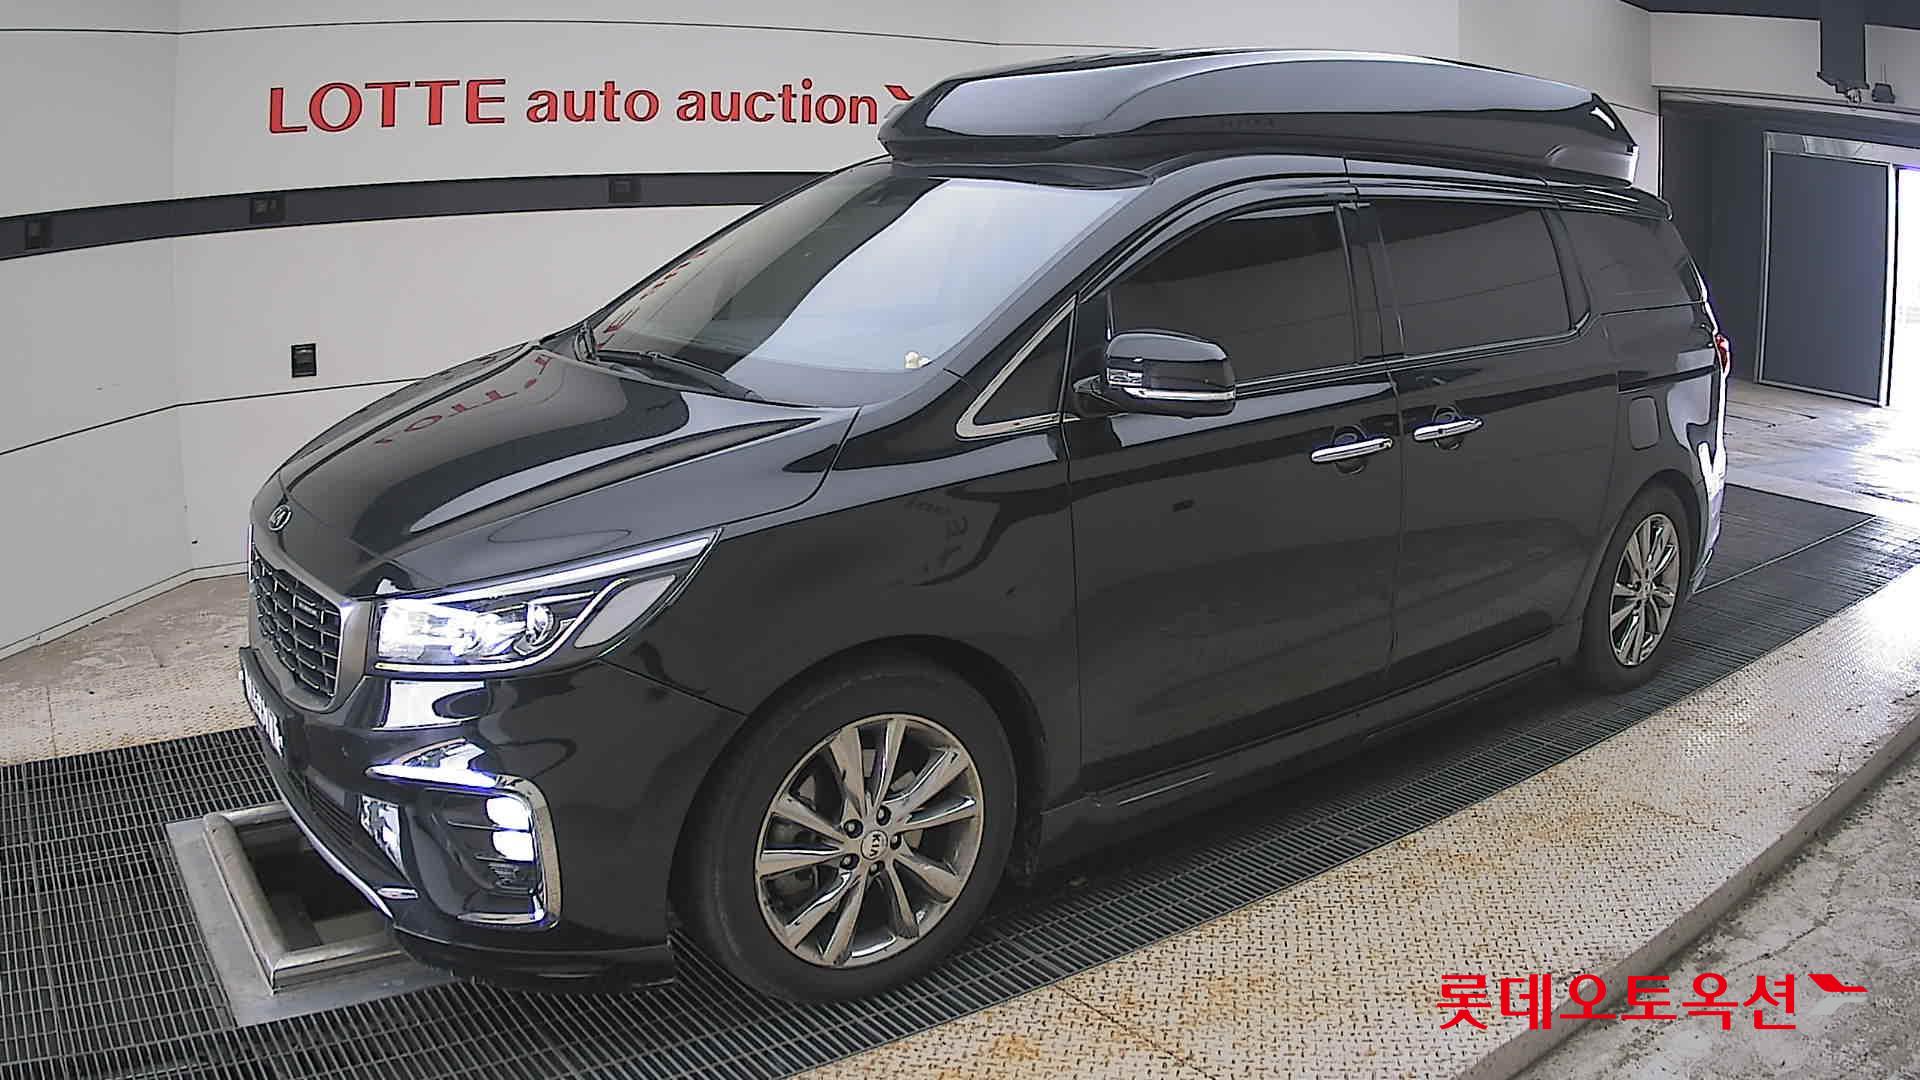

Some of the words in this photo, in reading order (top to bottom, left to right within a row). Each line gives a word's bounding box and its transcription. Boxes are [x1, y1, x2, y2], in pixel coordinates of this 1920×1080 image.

[268, 79, 506, 134] LOTTE
[526, 81, 661, 123] auto
[675, 79, 878, 124] auction
